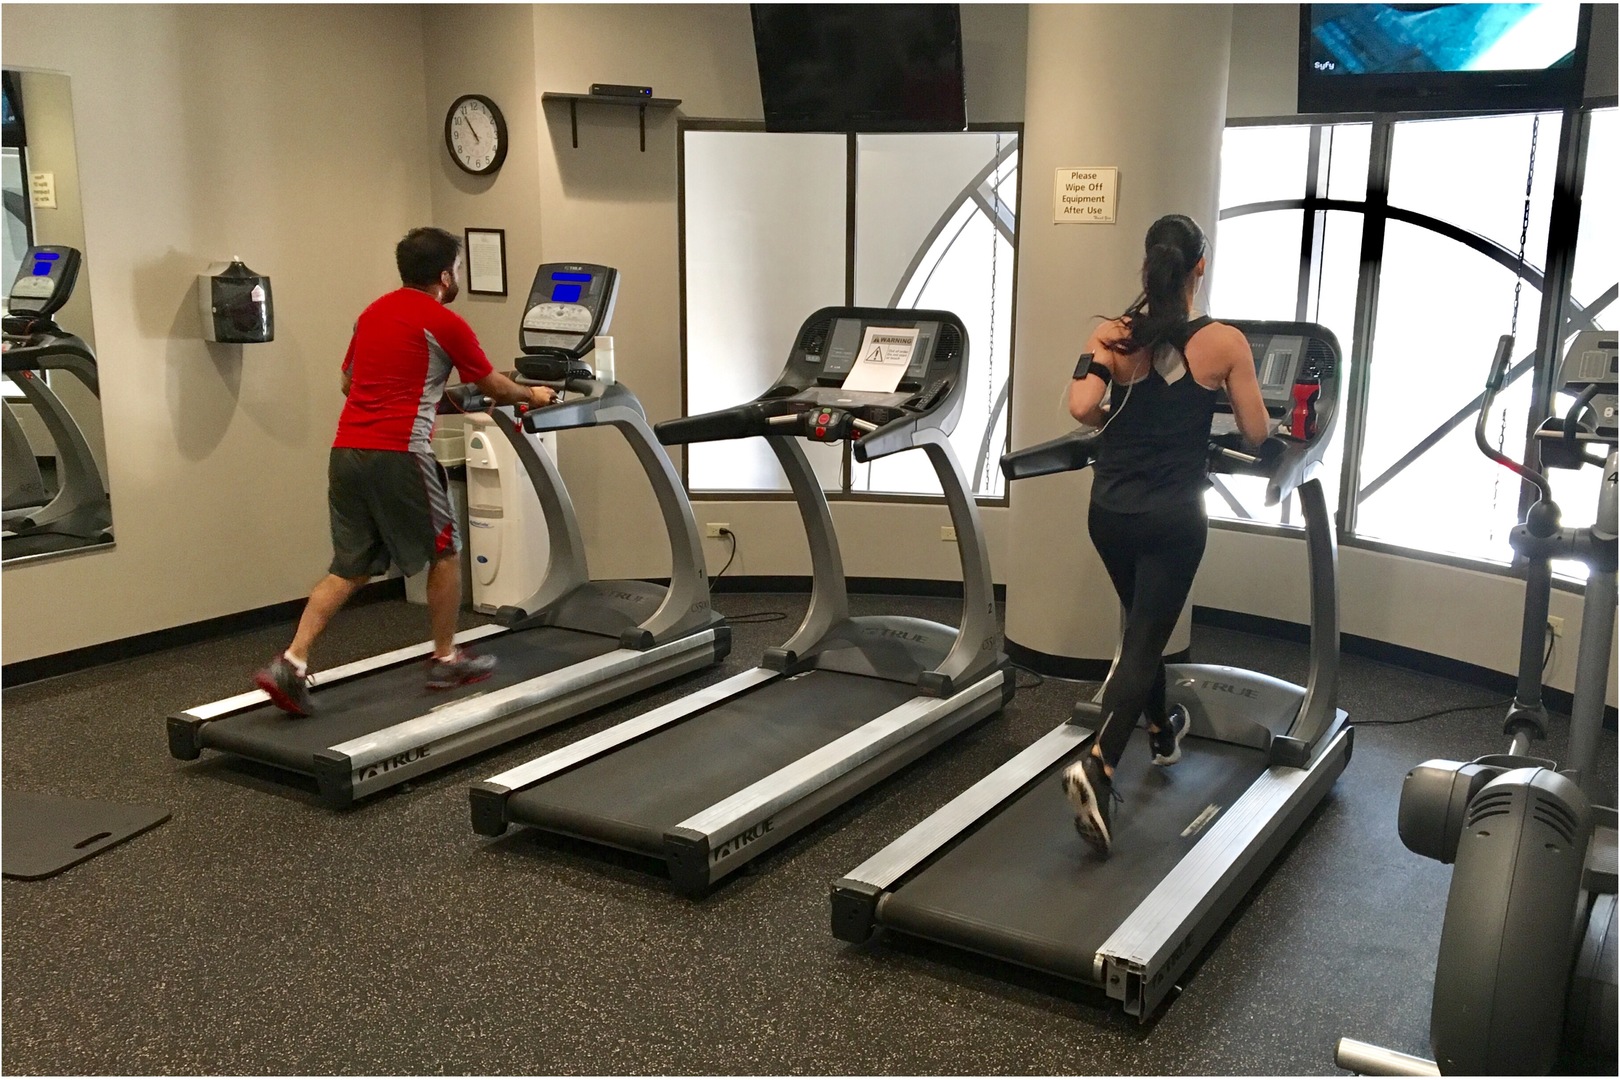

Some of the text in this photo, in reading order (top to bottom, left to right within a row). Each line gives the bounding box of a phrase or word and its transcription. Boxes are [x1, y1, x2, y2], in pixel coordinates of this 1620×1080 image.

[1314, 61, 1335, 70] Syfy
[470, 102, 478, 110] 12
[482, 106, 486, 114] 1
[454, 117, 461, 125] 10
[490, 116, 494, 124] 2
[454, 131, 458, 139] 9
[494, 131, 498, 139] 3
[458, 145, 462, 153] 8
[466, 156, 470, 164] 7
[476, 160, 480, 168] 6
[485, 156, 490, 164] 5
[1071, 172, 1097, 180] Please
[1066, 183, 1103, 192] Wipe Off
[1062, 195, 1105, 204] Equipment
[1064, 206, 1084, 214] After
[1608, 472, 1618, 484] 4
[698, 569, 702, 579] 1
[988, 603, 993, 614] 2
[882, 628, 929, 644] TRUE
[1201, 680, 1260, 700] TRUE
[381, 746, 430, 772] TRUE
[732, 819, 774, 850] TRUE
